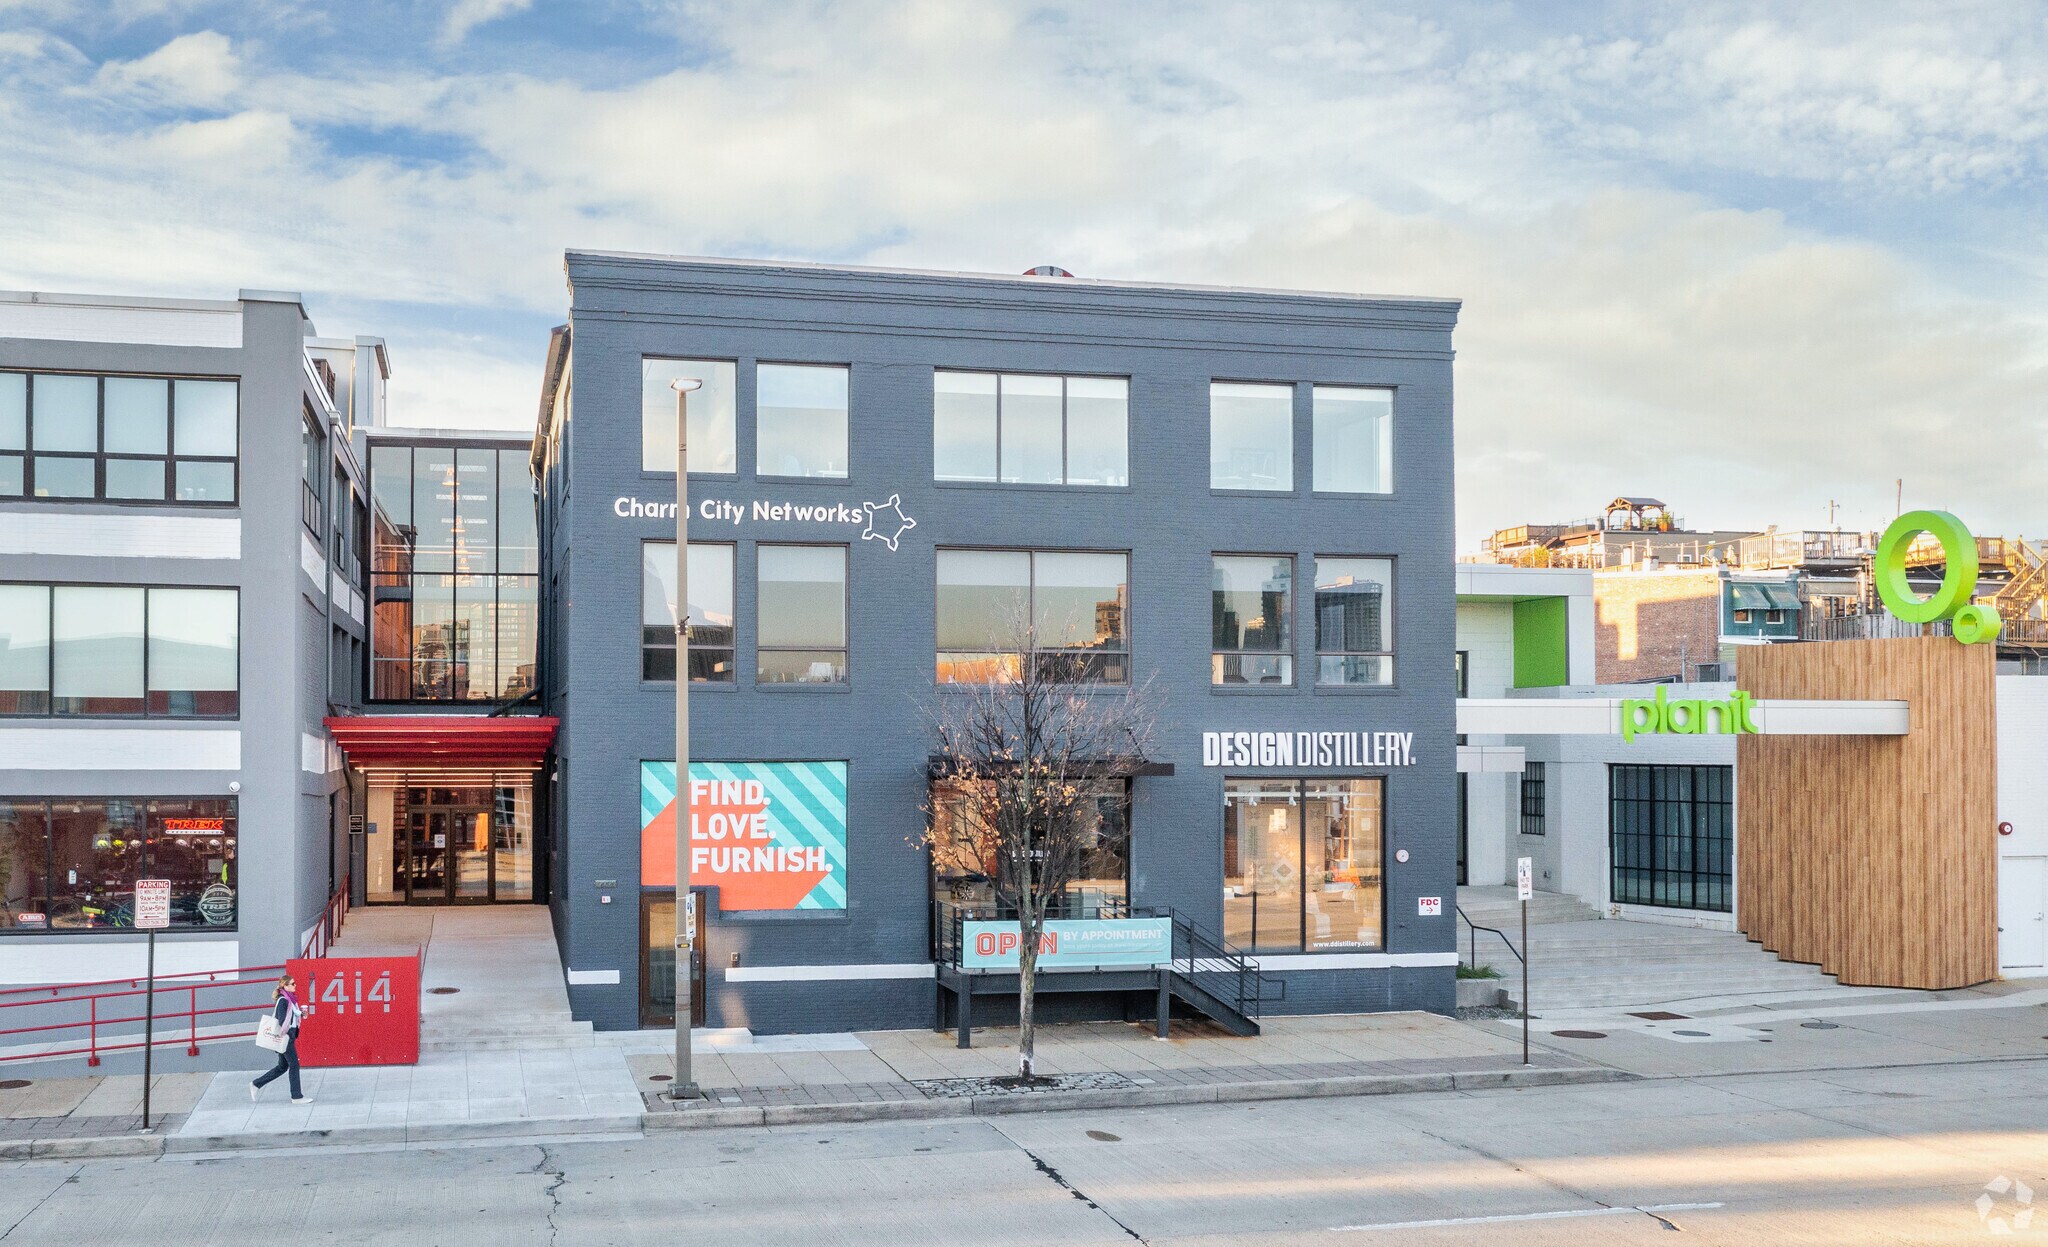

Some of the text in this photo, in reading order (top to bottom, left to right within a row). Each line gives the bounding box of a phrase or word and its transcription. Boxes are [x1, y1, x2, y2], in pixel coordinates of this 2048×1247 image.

[700, 499, 745, 525] City
[753, 501, 863, 524] Networks
[1622, 684, 1759, 745] planit
[1202, 732, 1293, 767] DESIGN
[691, 779, 772, 806] FIND.
[164, 819, 224, 830] TREK
[691, 813, 777, 840] LOVE.
[691, 846, 834, 874] FURNISH.
[138, 881, 169, 889] PARKING
[1420, 898, 1439, 906] FDC
[1063, 931, 1079, 941] BY
[1081, 929, 1162, 941] APPOINTMENT
[1312, 940, 1375, 948] www.ddistillery.com
[308, 970, 394, 1015] 1414
